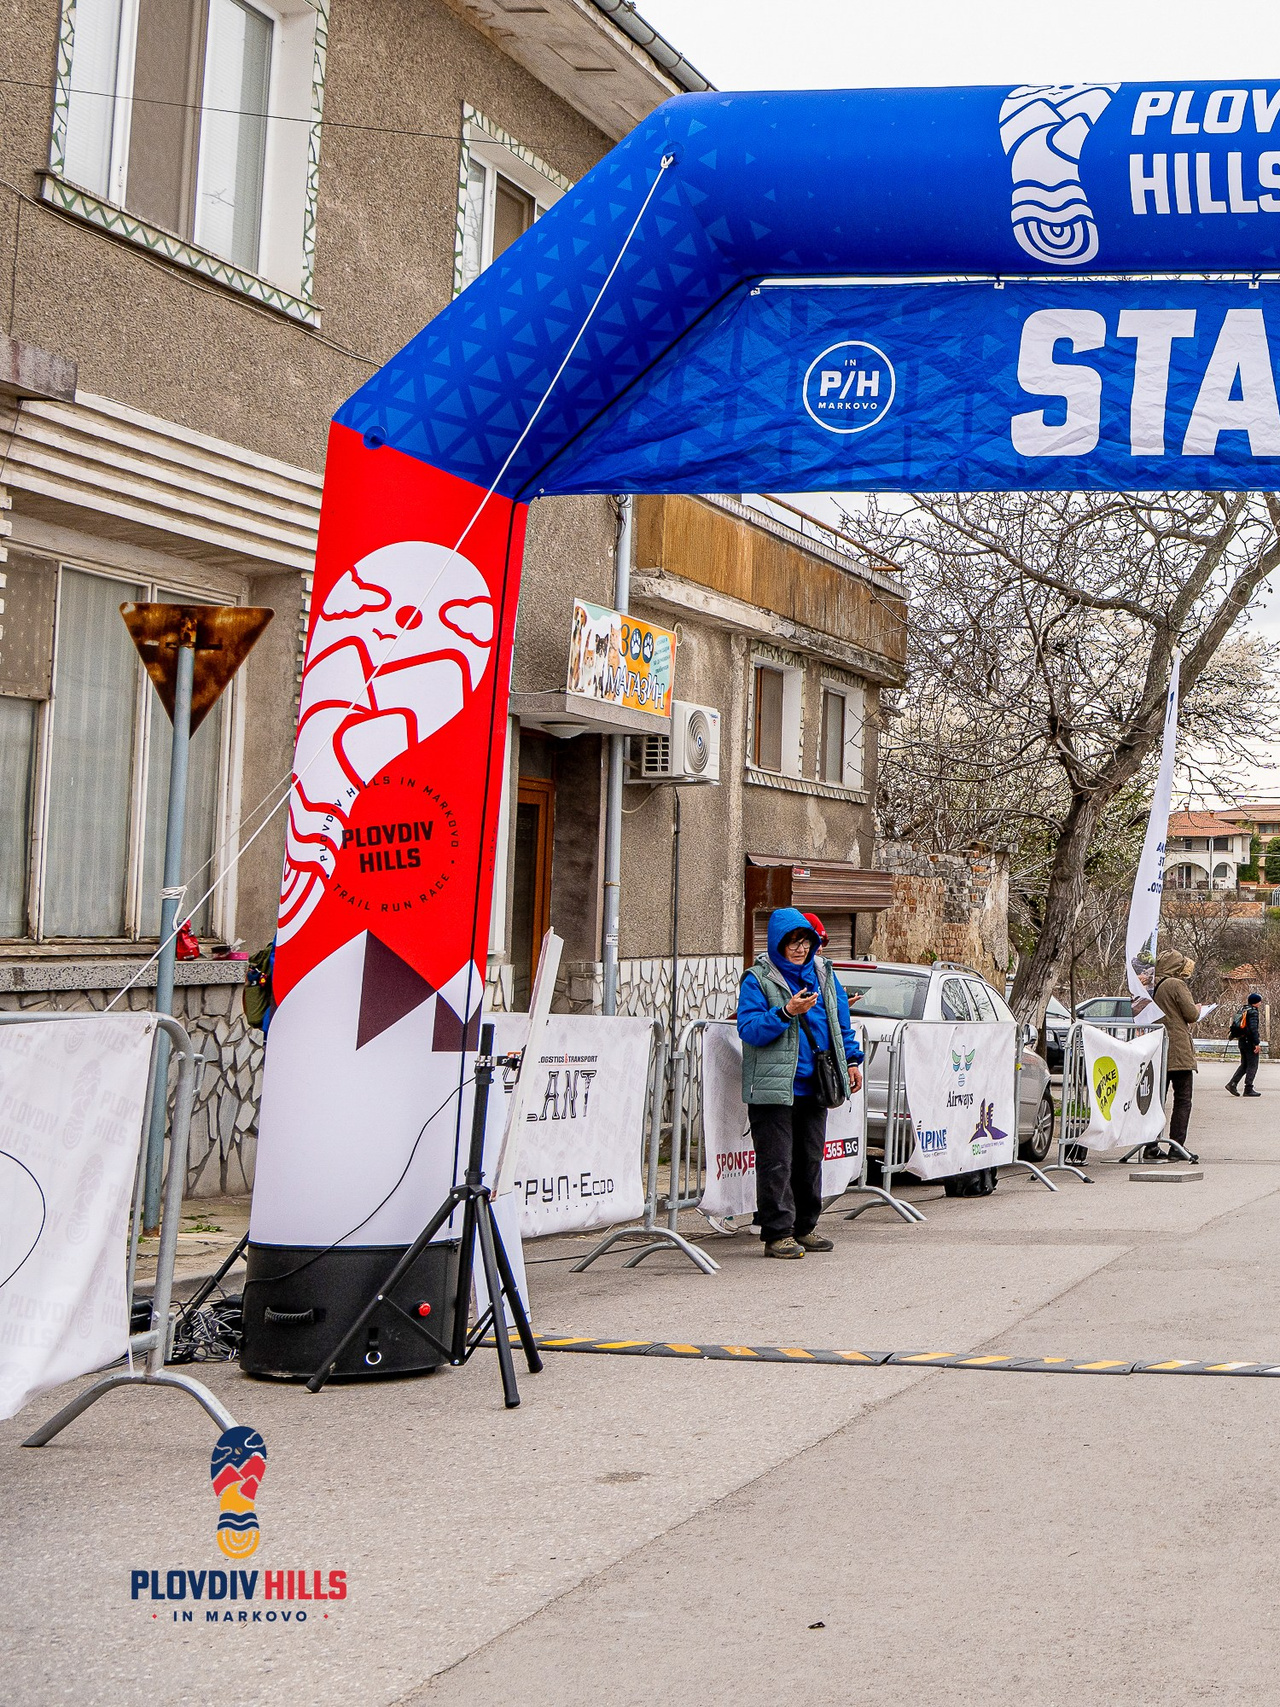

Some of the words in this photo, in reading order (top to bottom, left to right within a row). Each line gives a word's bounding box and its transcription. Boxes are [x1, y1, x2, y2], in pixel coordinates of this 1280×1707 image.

[820, 370, 880, 400] P/H
[817, 402, 878, 410] MARKOVO
[607, 665, 666, 710] МАГАЗИН
[320, 798, 343, 862] PLOVDIV
[346, 775, 390, 798] HILLS
[400, 776, 416, 788] IN
[422, 785, 460, 848] MARKOVO
[341, 820, 434, 850] PLOVDIV
[359, 847, 422, 874] HILLS
[333, 883, 371, 911] TRAIL
[380, 899, 413, 912] RUN
[419, 872, 450, 903] RACE
[568, 1055, 598, 1064] TRANSPORT
[946, 1090, 974, 1109] Airways
[825, 1140, 859, 1159] 365.BG
